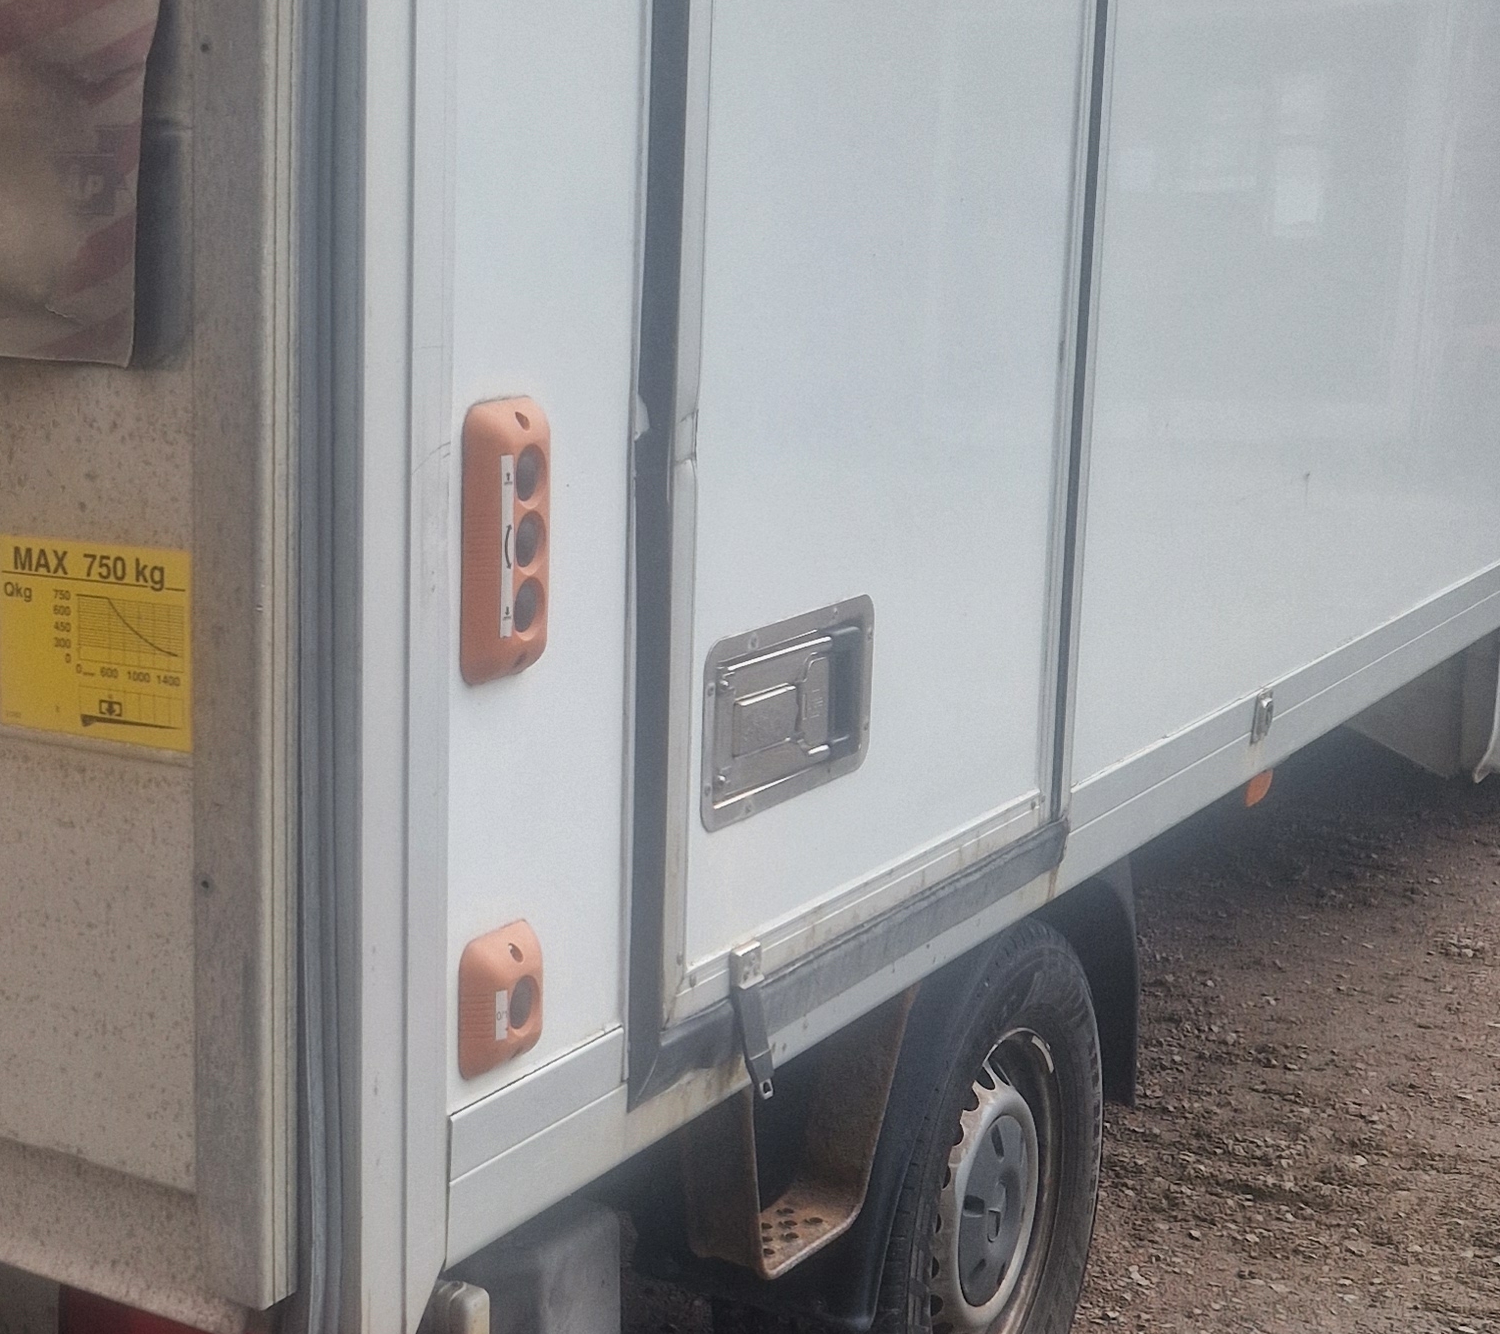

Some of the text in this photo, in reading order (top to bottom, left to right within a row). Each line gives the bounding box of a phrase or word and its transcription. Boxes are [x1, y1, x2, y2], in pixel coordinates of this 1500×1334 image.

[12, 545, 166, 592] MAX 750 kg
[3, 581, 33, 603] Qkg
[52, 588, 71, 601] 750
[52, 604, 72, 616] 600
[53, 621, 72, 633] 450
[53, 637, 72, 649] 300
[64, 653, 72, 664] 0
[75, 663, 83, 674] 0
[99, 666, 119, 679] 600
[127, 670, 151, 683] 1000
